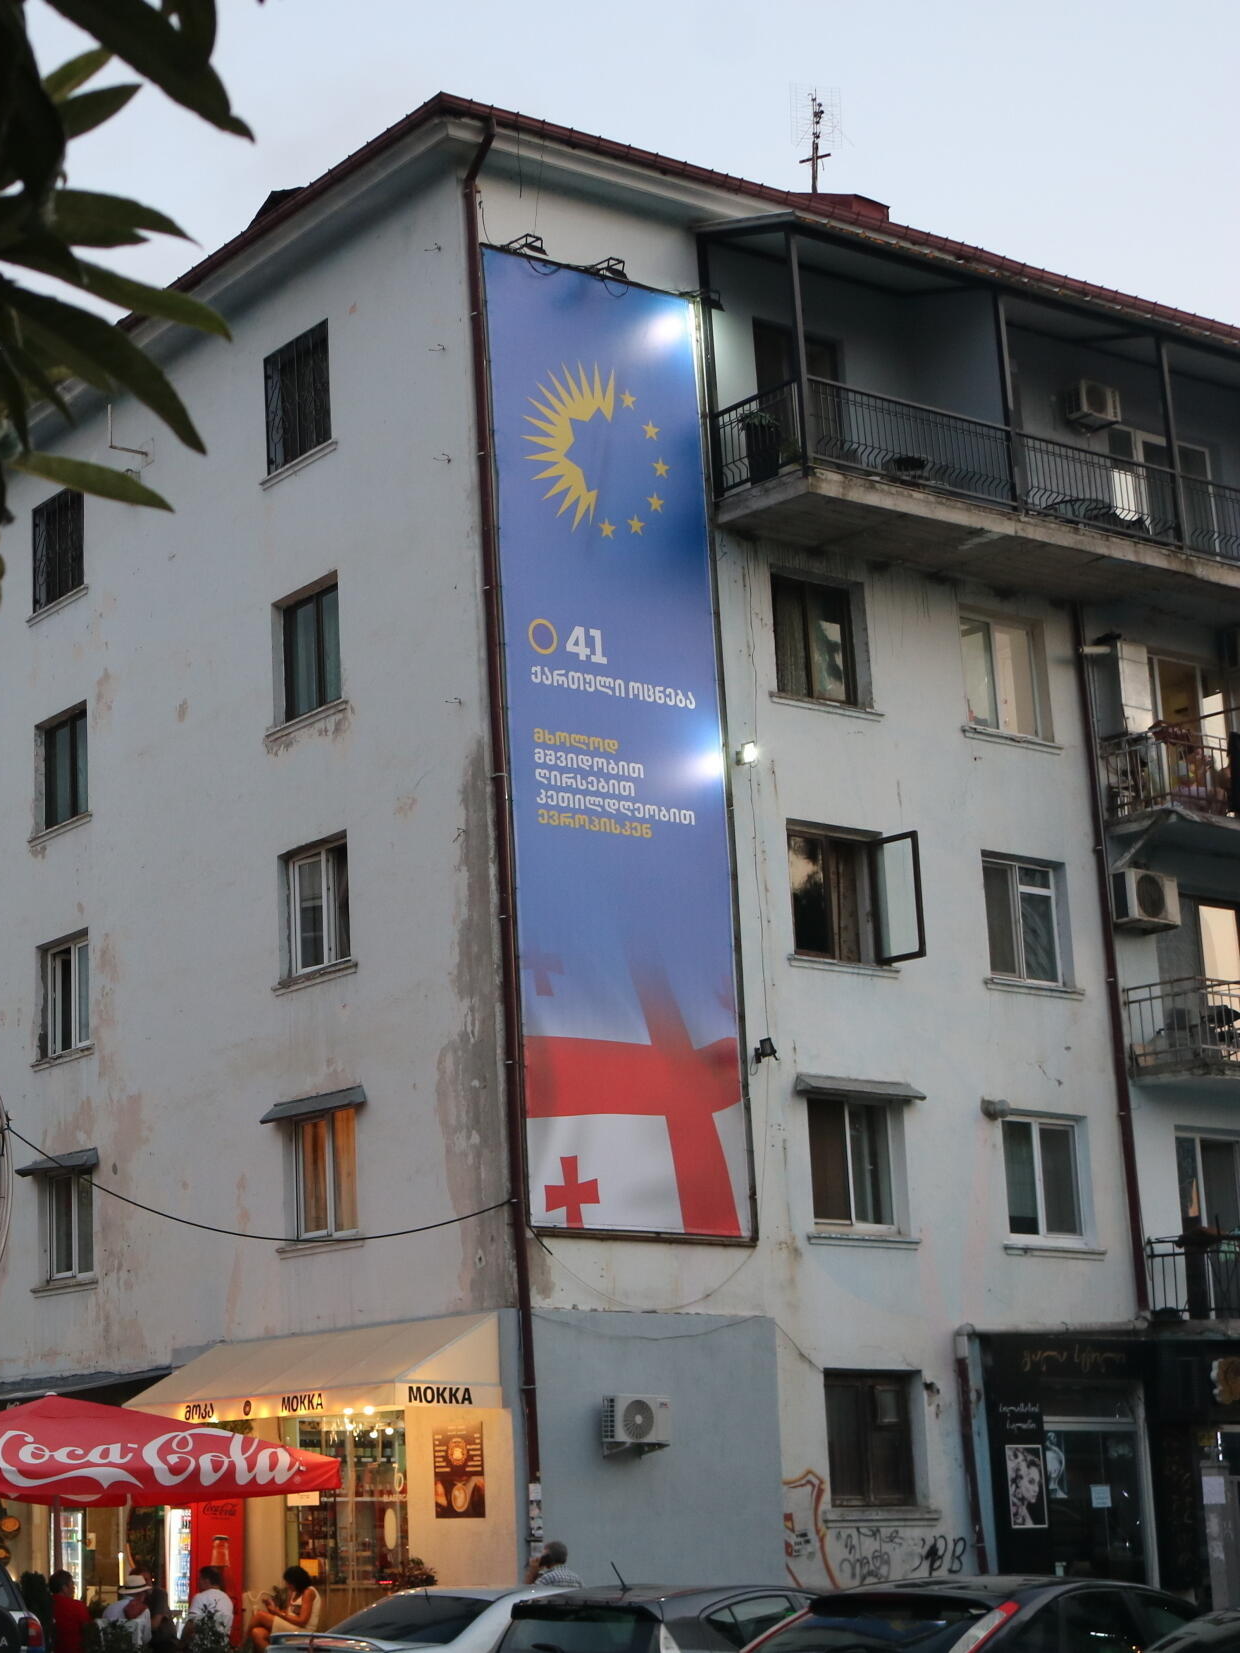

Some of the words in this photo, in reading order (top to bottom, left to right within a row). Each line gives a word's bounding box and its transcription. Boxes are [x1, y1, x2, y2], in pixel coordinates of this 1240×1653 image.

[565, 625, 608, 665] 41
[531, 665, 625, 698] ქართული
[629, 681, 696, 710] ოცნება
[533, 727, 619, 755] მხოლოდ
[534, 748, 645, 779] მშვიდობით
[535, 768, 636, 797] ღირსებით
[536, 789, 696, 826] კეთილდღეობით
[537, 809, 653, 838] ევროპისკენ
[281, 1393, 324, 1413] MOKKA
[408, 1385, 473, 1405] MOKKA
[184, 1402, 214, 1421] მოკა
